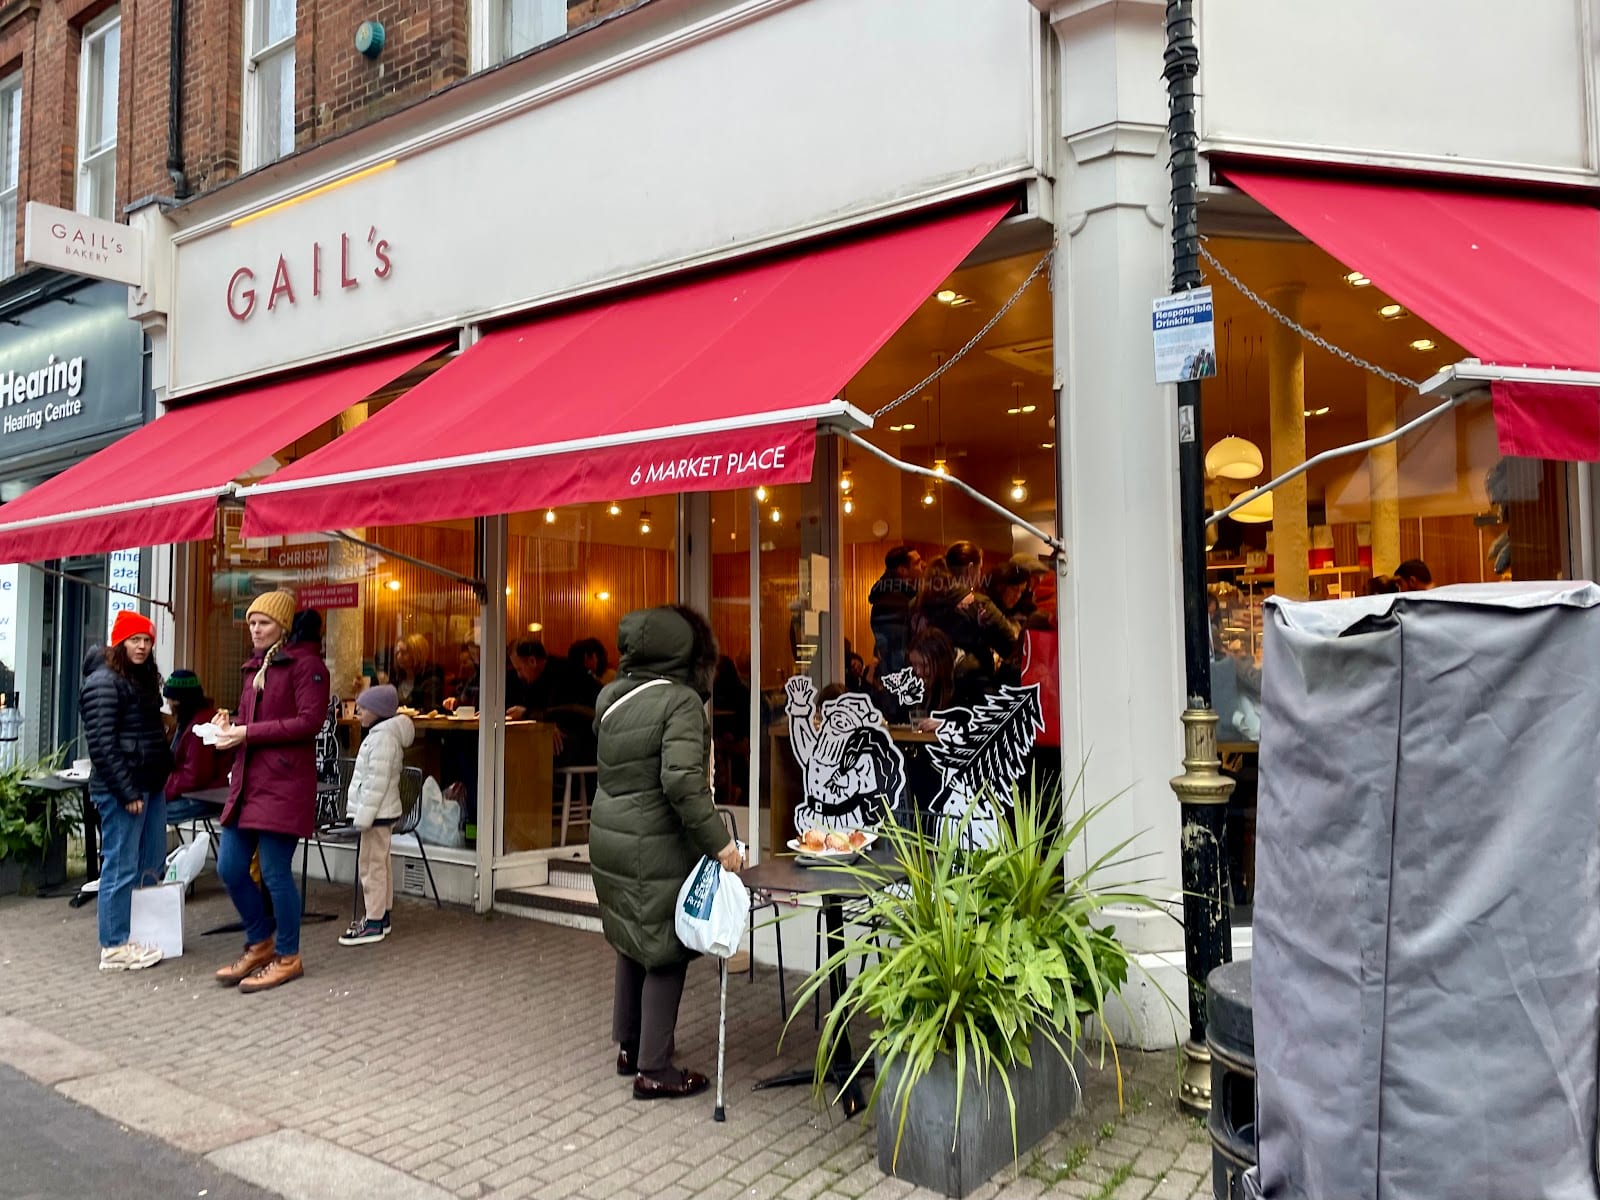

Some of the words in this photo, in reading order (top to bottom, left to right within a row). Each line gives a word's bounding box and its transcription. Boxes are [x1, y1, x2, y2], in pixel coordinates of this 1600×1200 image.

[66, 245, 109, 263] BAKERY
[1155, 303, 1212, 320] Responsible
[1155, 315, 1195, 329] Drinking
[0, 353, 83, 409] Hearing
[4, 408, 42, 434] Hearing
[45, 399, 81, 422] Centre
[630, 465, 642, 486] 6
[645, 454, 723, 484] MARKET
[727, 445, 786, 475] PLACE
